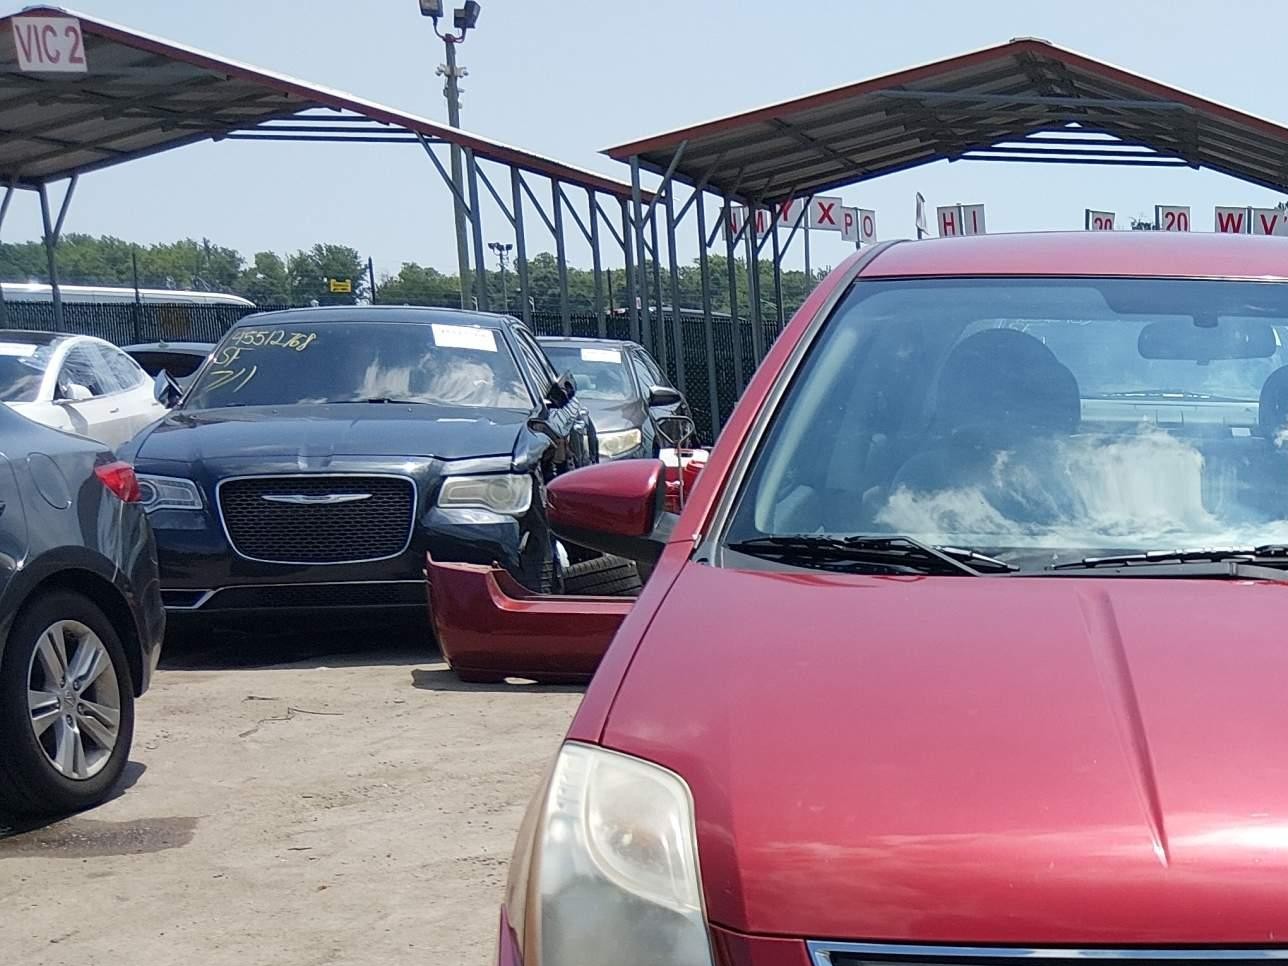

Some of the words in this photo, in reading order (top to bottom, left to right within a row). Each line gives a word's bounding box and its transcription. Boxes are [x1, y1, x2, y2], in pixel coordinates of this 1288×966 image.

[15, 24, 61, 64] VIC
[65, 25, 84, 64] 2
[817, 202, 836, 225] X
[844, 213, 853, 235] P
[942, 211, 956, 235] H
[1164, 211, 1188, 231] 20
[1217, 212, 1244, 234] W
